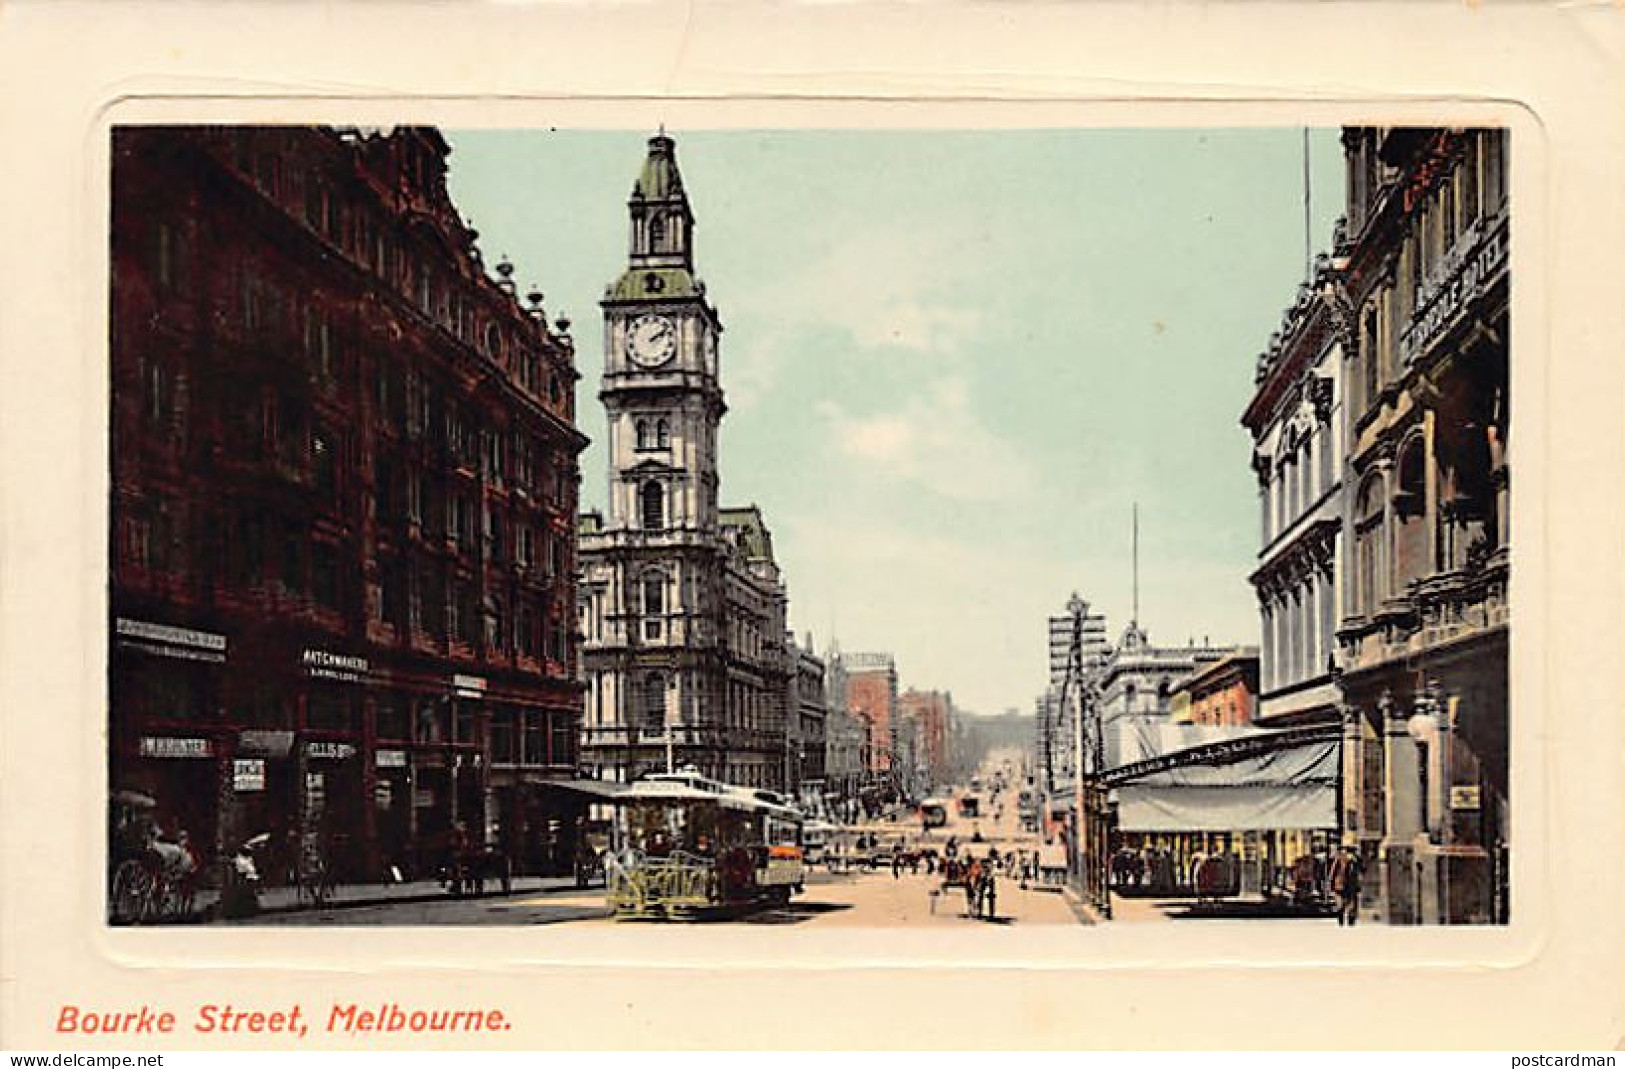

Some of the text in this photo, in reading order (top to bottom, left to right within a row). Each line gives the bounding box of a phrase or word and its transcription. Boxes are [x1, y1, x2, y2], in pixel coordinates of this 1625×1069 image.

[57, 1004, 512, 1038] Bourke Street, Melbourne.
